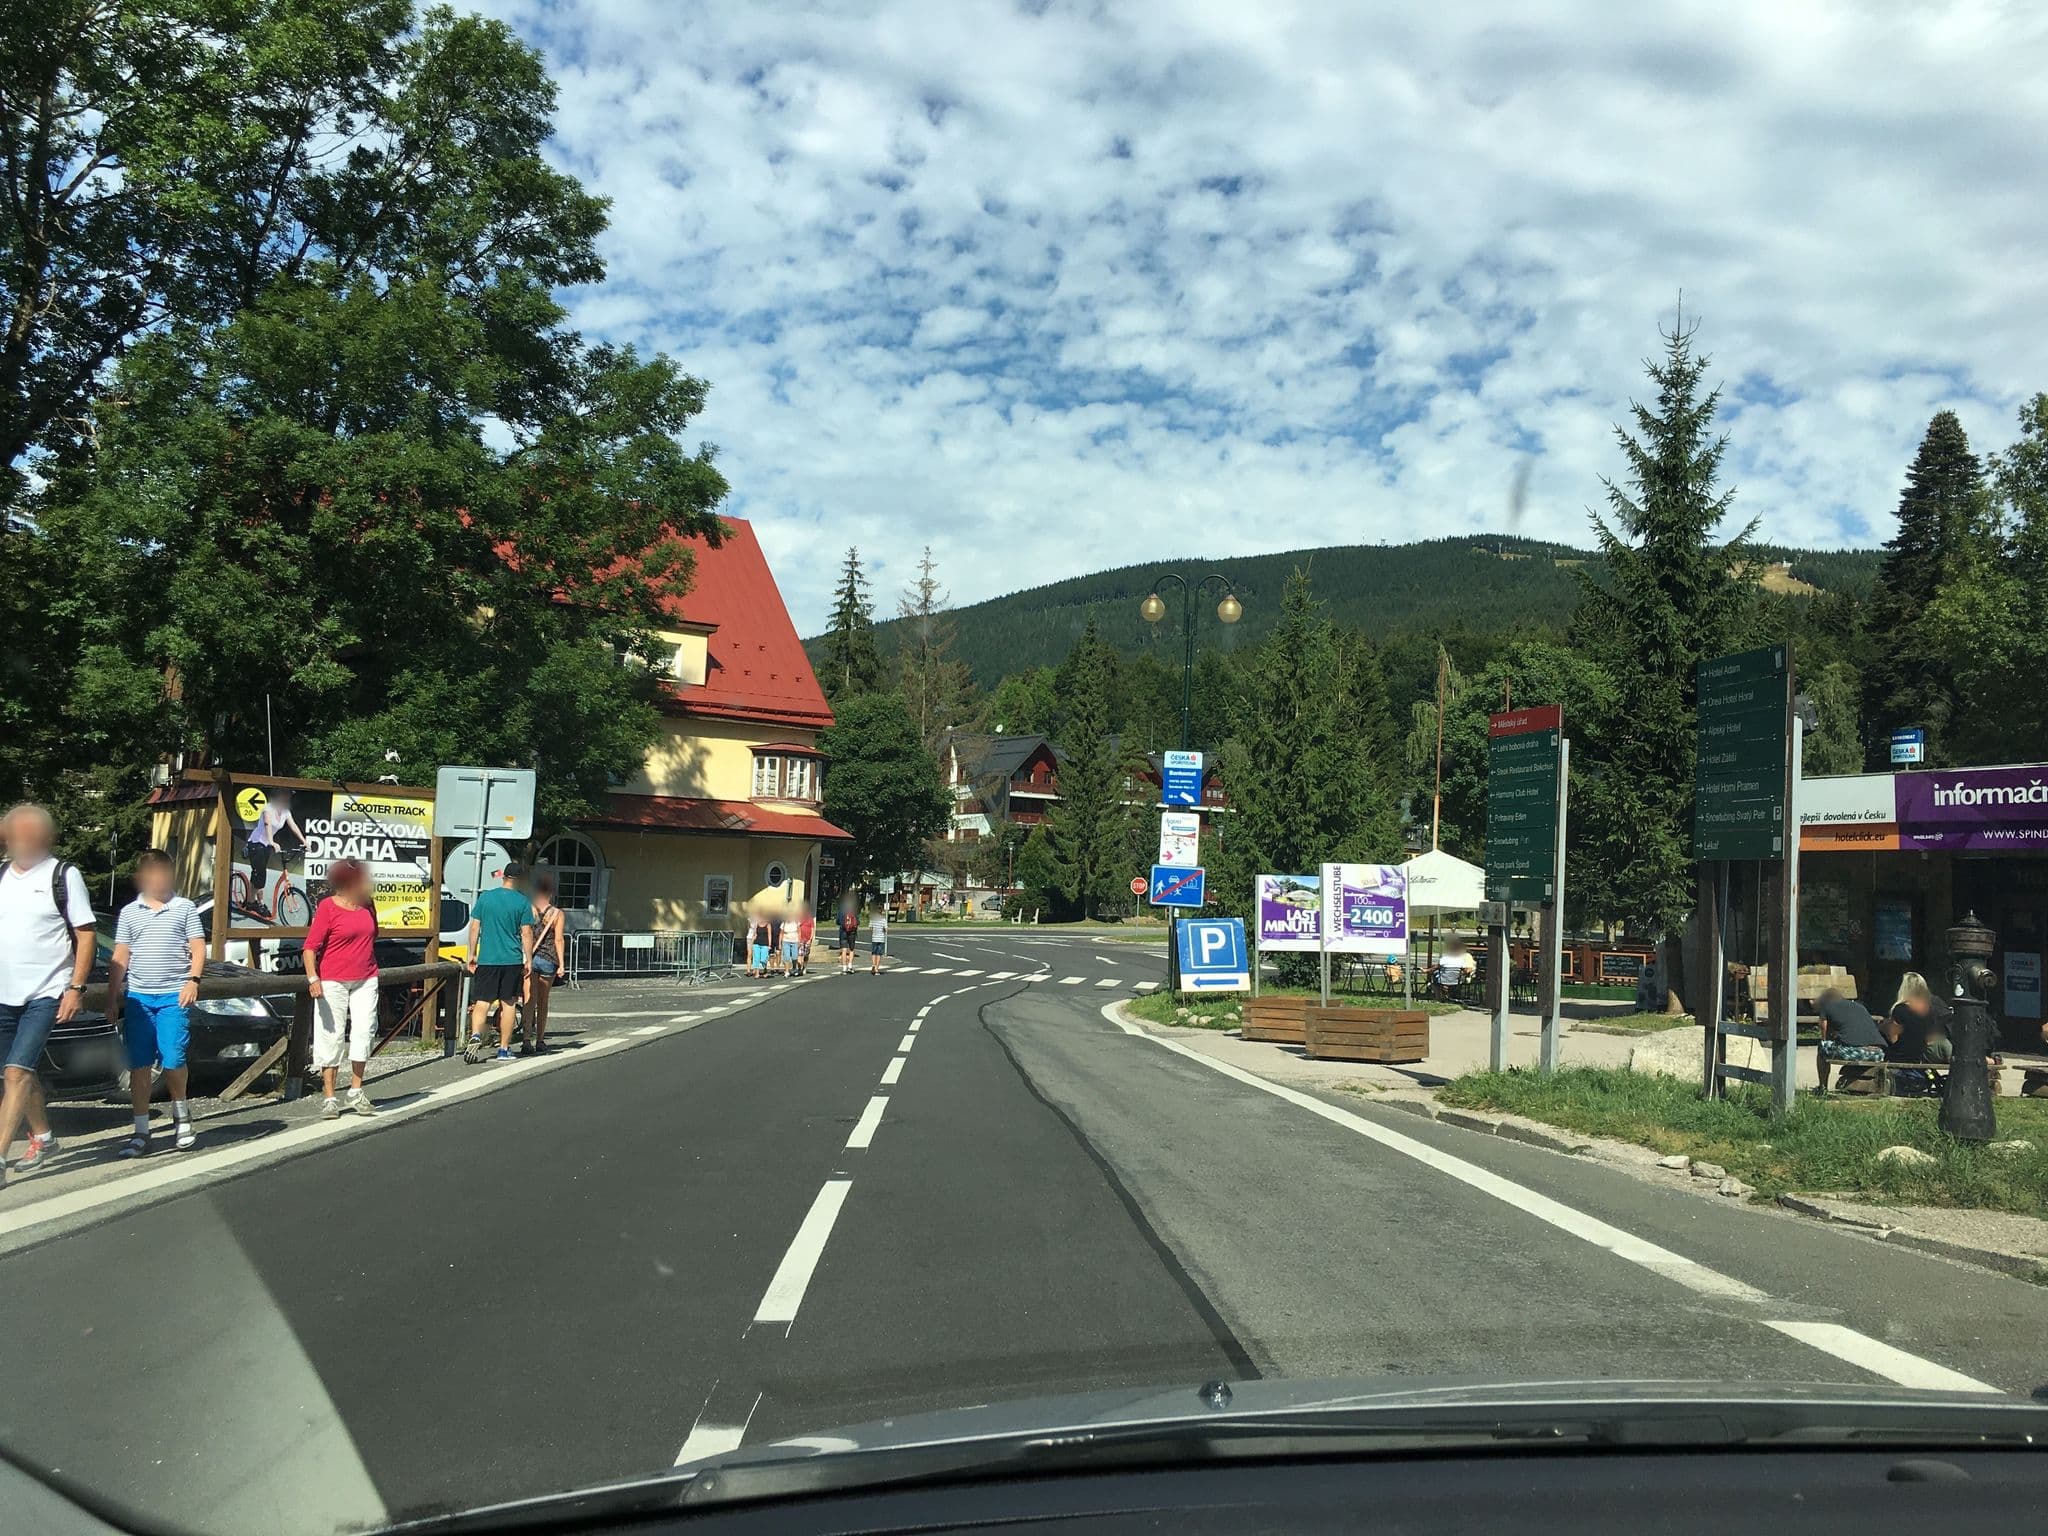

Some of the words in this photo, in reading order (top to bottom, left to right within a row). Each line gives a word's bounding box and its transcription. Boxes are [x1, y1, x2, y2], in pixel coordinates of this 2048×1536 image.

[343, 802, 392, 815] SCOOTER
[393, 805, 426, 816] TRACK
[1799, 812, 1822, 824] ejlepší
[1823, 810, 1856, 821] dovolená
[1864, 809, 1886, 820] Česku
[305, 818, 427, 839] KOLOBĚŽKOVÁ
[304, 836, 398, 862] DRÁHA
[1333, 865, 1341, 932] WECHSELSTUBE
[1286, 909, 1317, 921] LAST
[1264, 920, 1317, 933] MINUTE
[1200, 927, 1226, 964] P
